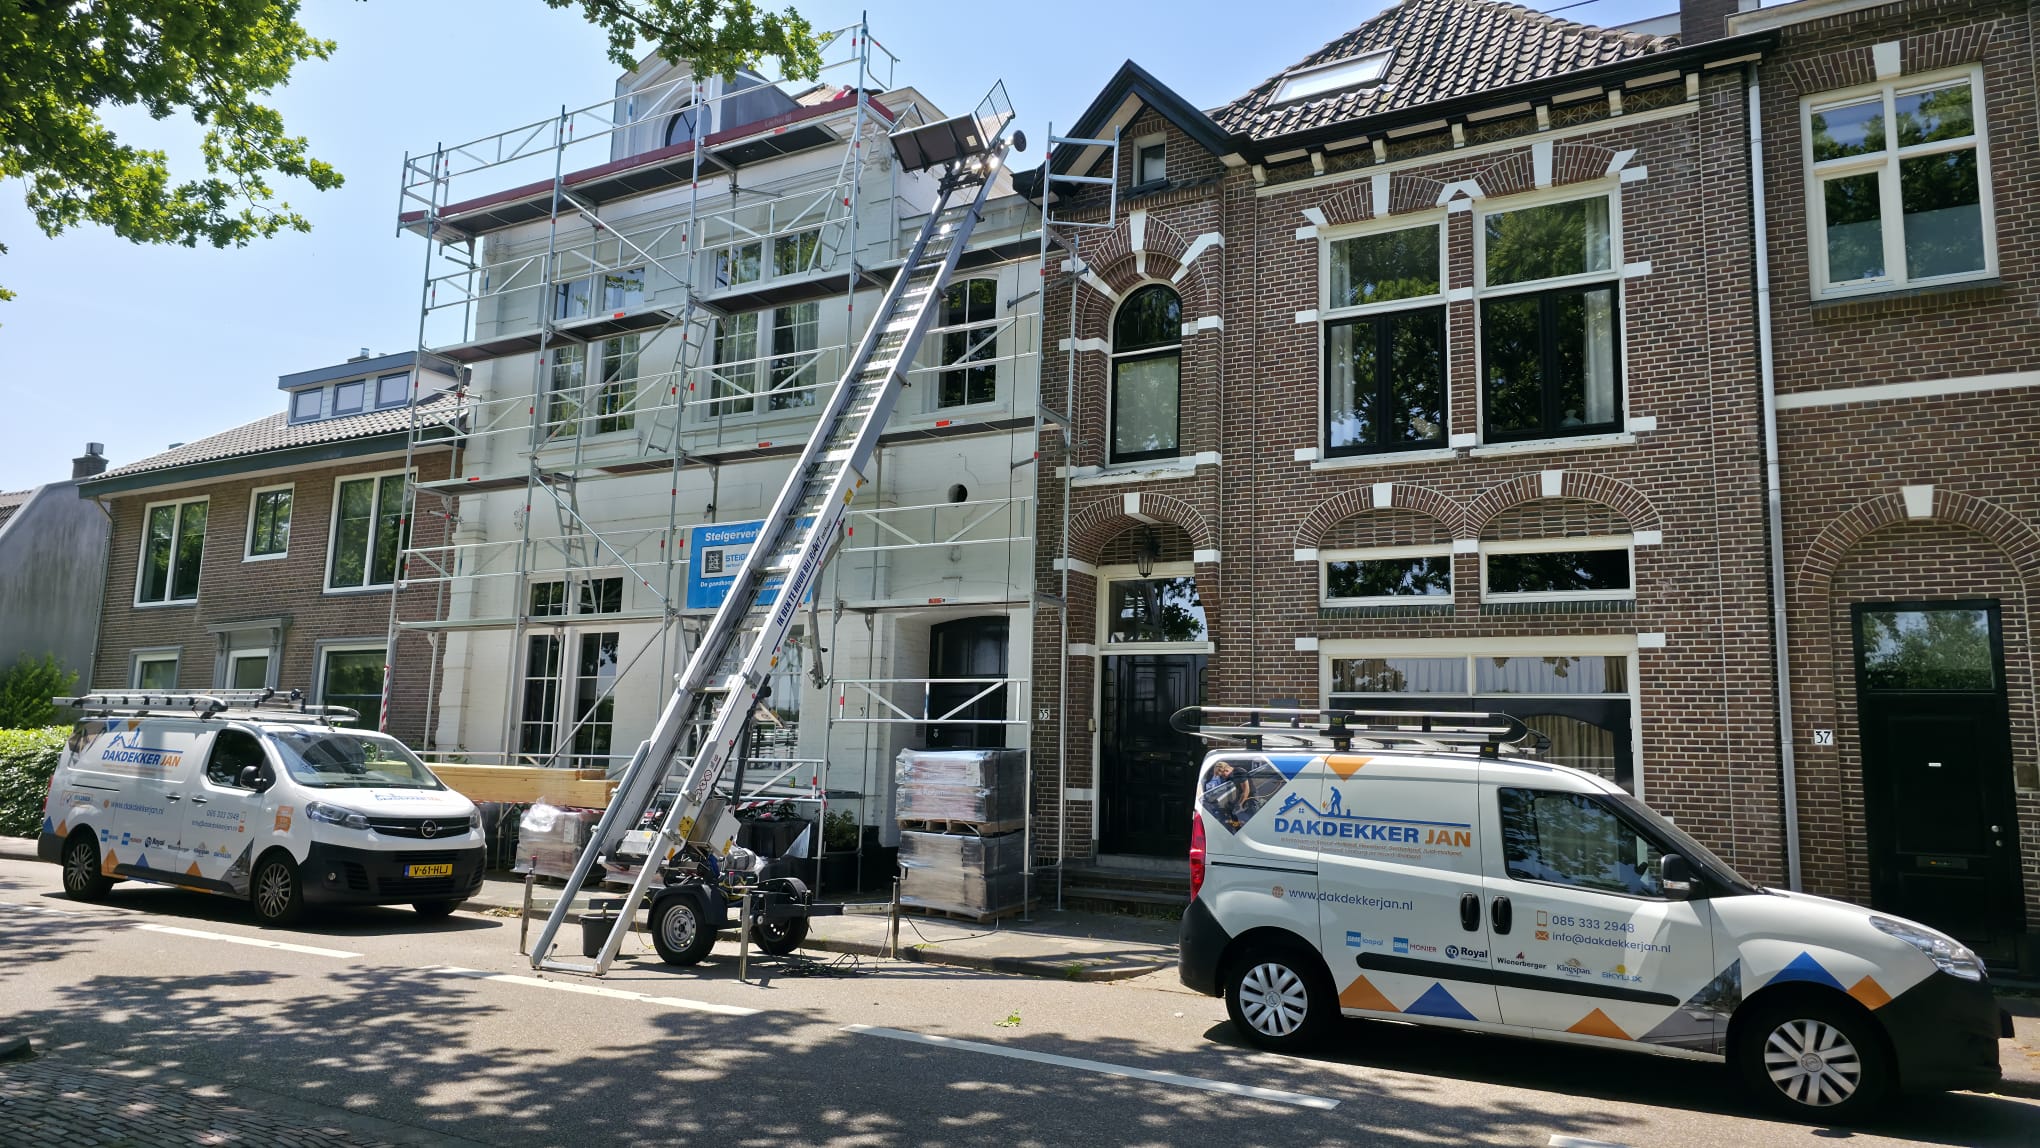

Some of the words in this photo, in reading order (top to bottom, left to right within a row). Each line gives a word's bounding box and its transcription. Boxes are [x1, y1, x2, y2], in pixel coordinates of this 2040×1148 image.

[781, 600, 792, 620] BEN
[788, 589, 797, 602] TE
[793, 571, 807, 593] HUUR
[1039, 709, 1049, 720] 35
[1815, 730, 1831, 744] 37
[102, 749, 161, 765] DAKDEKKER
[160, 755, 181, 767] JAN
[1274, 817, 1419, 844] DAKDEKKER
[1424, 829, 1471, 848] JAN
[1289, 889, 1413, 911] www.dakdekkerjan.nl
[1552, 915, 1575, 927] 085
[1579, 917, 1600, 930] 333
[1604, 920, 1635, 934] 2948
[1552, 932, 1671, 953] info@dakdekkerjan.nl
[1460, 946, 1488, 959] Royal
[1556, 964, 1591, 976] Kingspan
